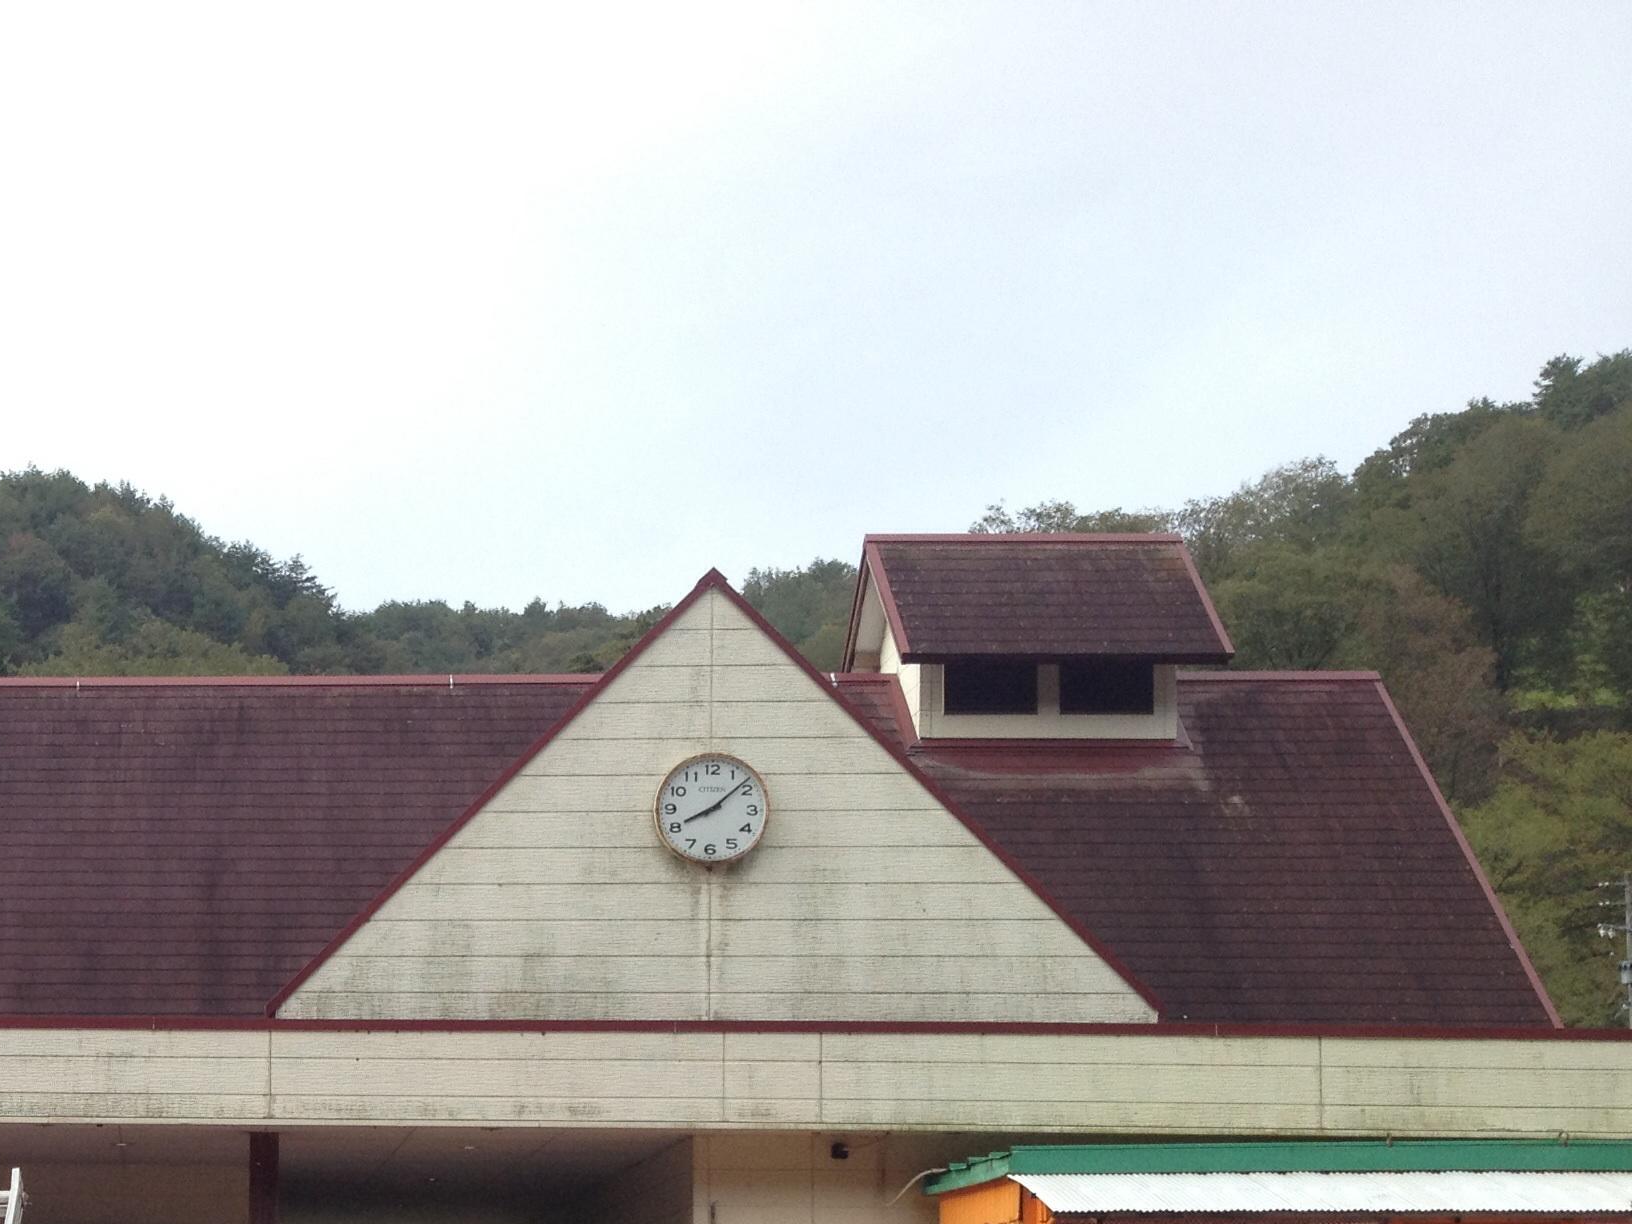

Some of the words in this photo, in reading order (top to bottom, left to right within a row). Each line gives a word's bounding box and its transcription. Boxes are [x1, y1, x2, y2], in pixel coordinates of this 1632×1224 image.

[705, 764, 720, 776] 12
[730, 770, 735, 780] 1
[684, 771, 699, 782] 11
[670, 786, 687, 797] 10
[741, 785, 753, 796] 2
[664, 803, 677, 815] 9
[746, 805, 758, 816] 3
[669, 822, 682, 833] 8
[739, 823, 752, 834] 4
[685, 839, 697, 849] 7
[726, 838, 738, 849] 5
[704, 844, 717, 855] 6
